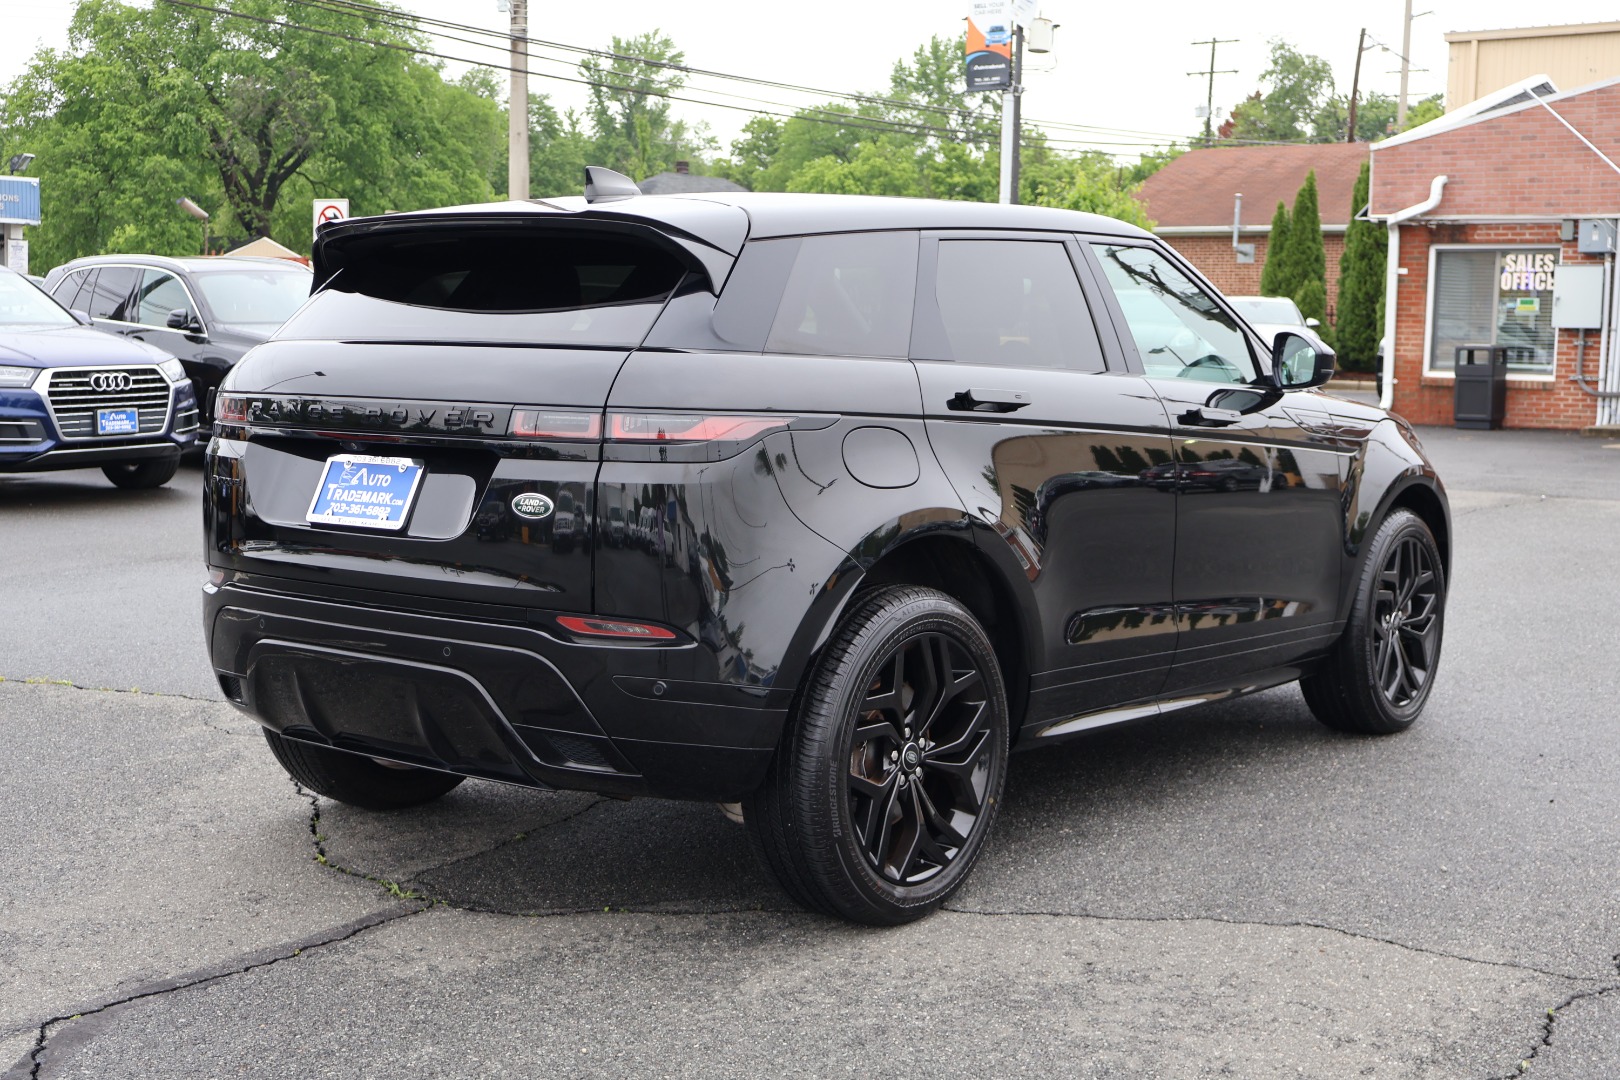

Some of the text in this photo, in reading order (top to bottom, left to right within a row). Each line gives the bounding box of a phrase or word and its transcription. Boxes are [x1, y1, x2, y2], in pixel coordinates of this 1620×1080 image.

[1505, 253, 1555, 273] SALES
[1500, 272, 1555, 291] OFFICE
[250, 401, 346, 421] RANGE
[365, 407, 495, 429] ROVER
[350, 467, 392, 488] AUTO
[520, 498, 540, 506] LAND
[521, 505, 545, 514] ROVER
[828, 758, 842, 839] BRIDGESTONE
